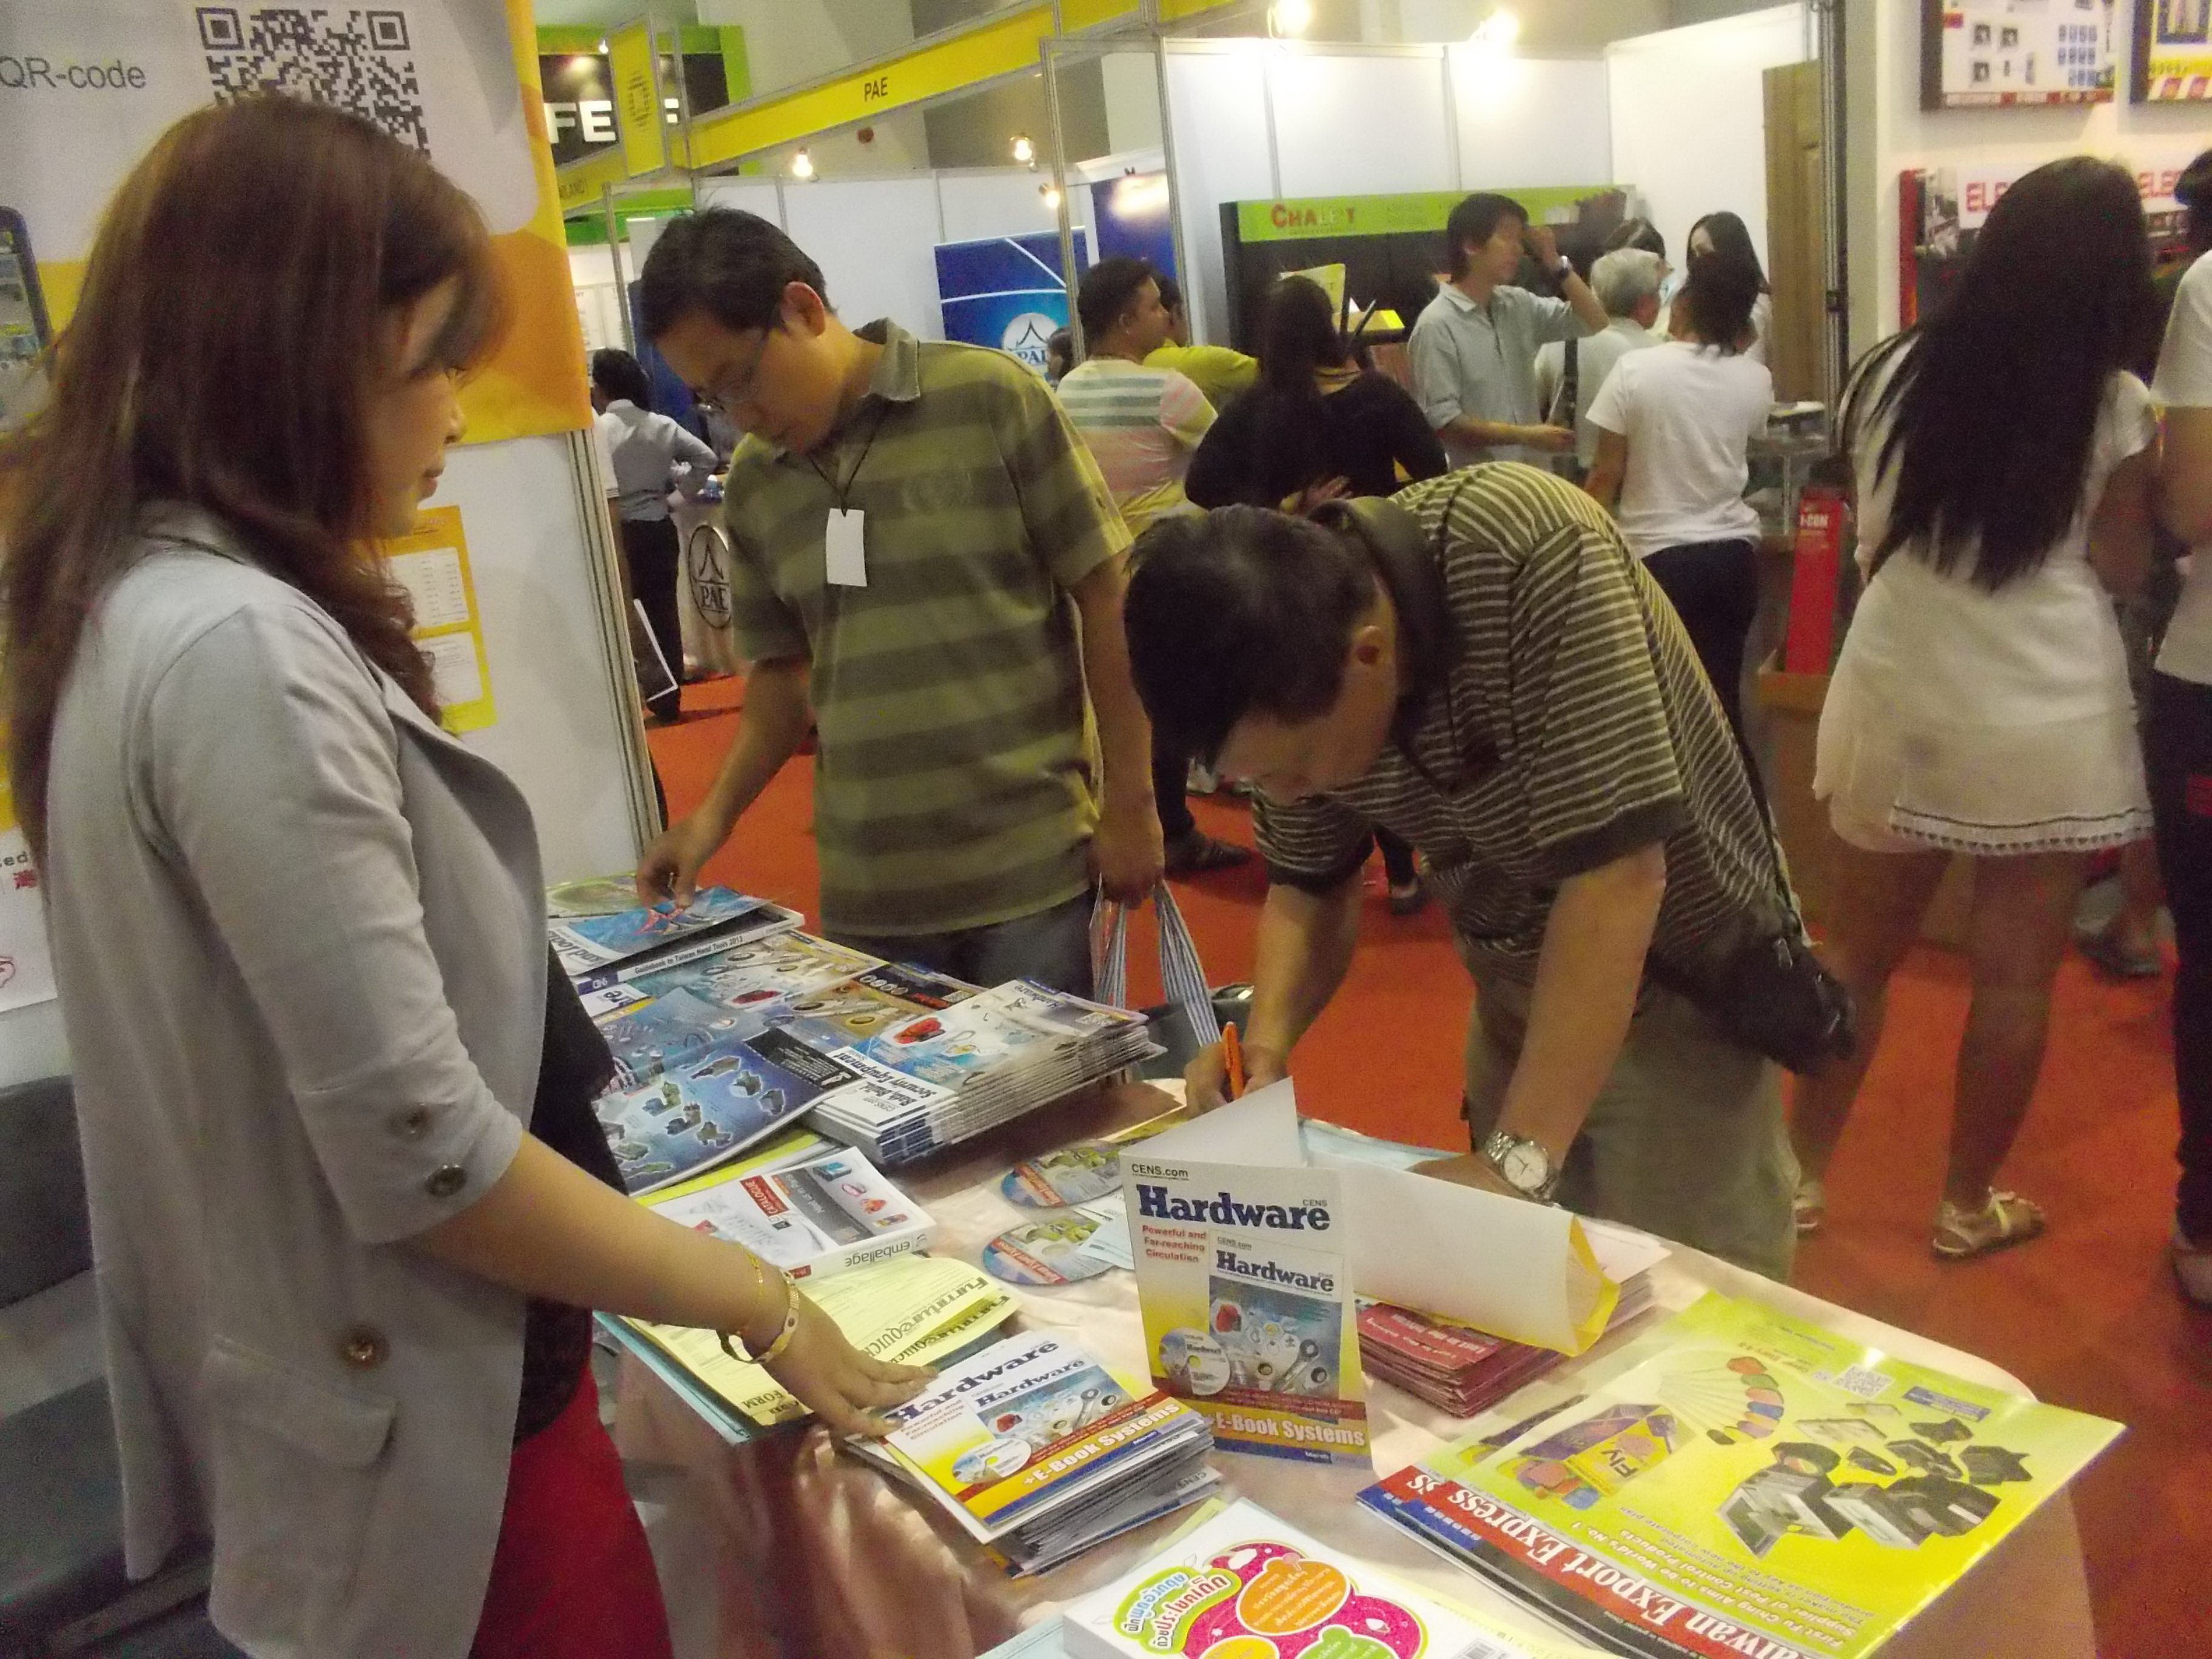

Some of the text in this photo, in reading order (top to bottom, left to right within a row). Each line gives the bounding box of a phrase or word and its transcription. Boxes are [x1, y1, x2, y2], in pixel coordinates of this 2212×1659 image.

[0, 57, 147, 89] QR-code
[864, 77, 888, 102] PAE
[700, 586, 728, 611] PAE
[1131, 1163, 1188, 1178] CENS.com
[745, 1179, 779, 1216] CATALOGUE
[1136, 1184, 1330, 1231] Hardware
[1302, 1198, 1327, 1207] CENS
[1142, 1224, 1207, 1240] Powerful and
[1144, 1236, 1205, 1253] Far-reaching
[1217, 1236, 1252, 1249] CENS.com
[845, 1241, 910, 1267] emballage
[1145, 1248, 1199, 1263] Circulation
[1216, 1250, 1334, 1292] Hardware
[885, 1341, 1059, 1421] Hardware
[975, 1359, 1085, 1407] Hardware
[1023, 1444, 1101, 1486] +E-Book
[1098, 1403, 1181, 1447] Systems
[1281, 1419, 1365, 1446] Systems
[1447, 1489, 1570, 1566] Express
[1587, 1527, 1607, 1541] No.
[1608, 1540, 1657, 1569] World's
[1620, 1529, 1857, 1636] Supplier of Pest Control Products
[1660, 1568, 1680, 1580] be
[1681, 1578, 1697, 1588] to
[1561, 1550, 1691, 1626] Export
[1698, 1585, 1737, 1604] Aims
[1805, 1627, 1845, 1648] First
